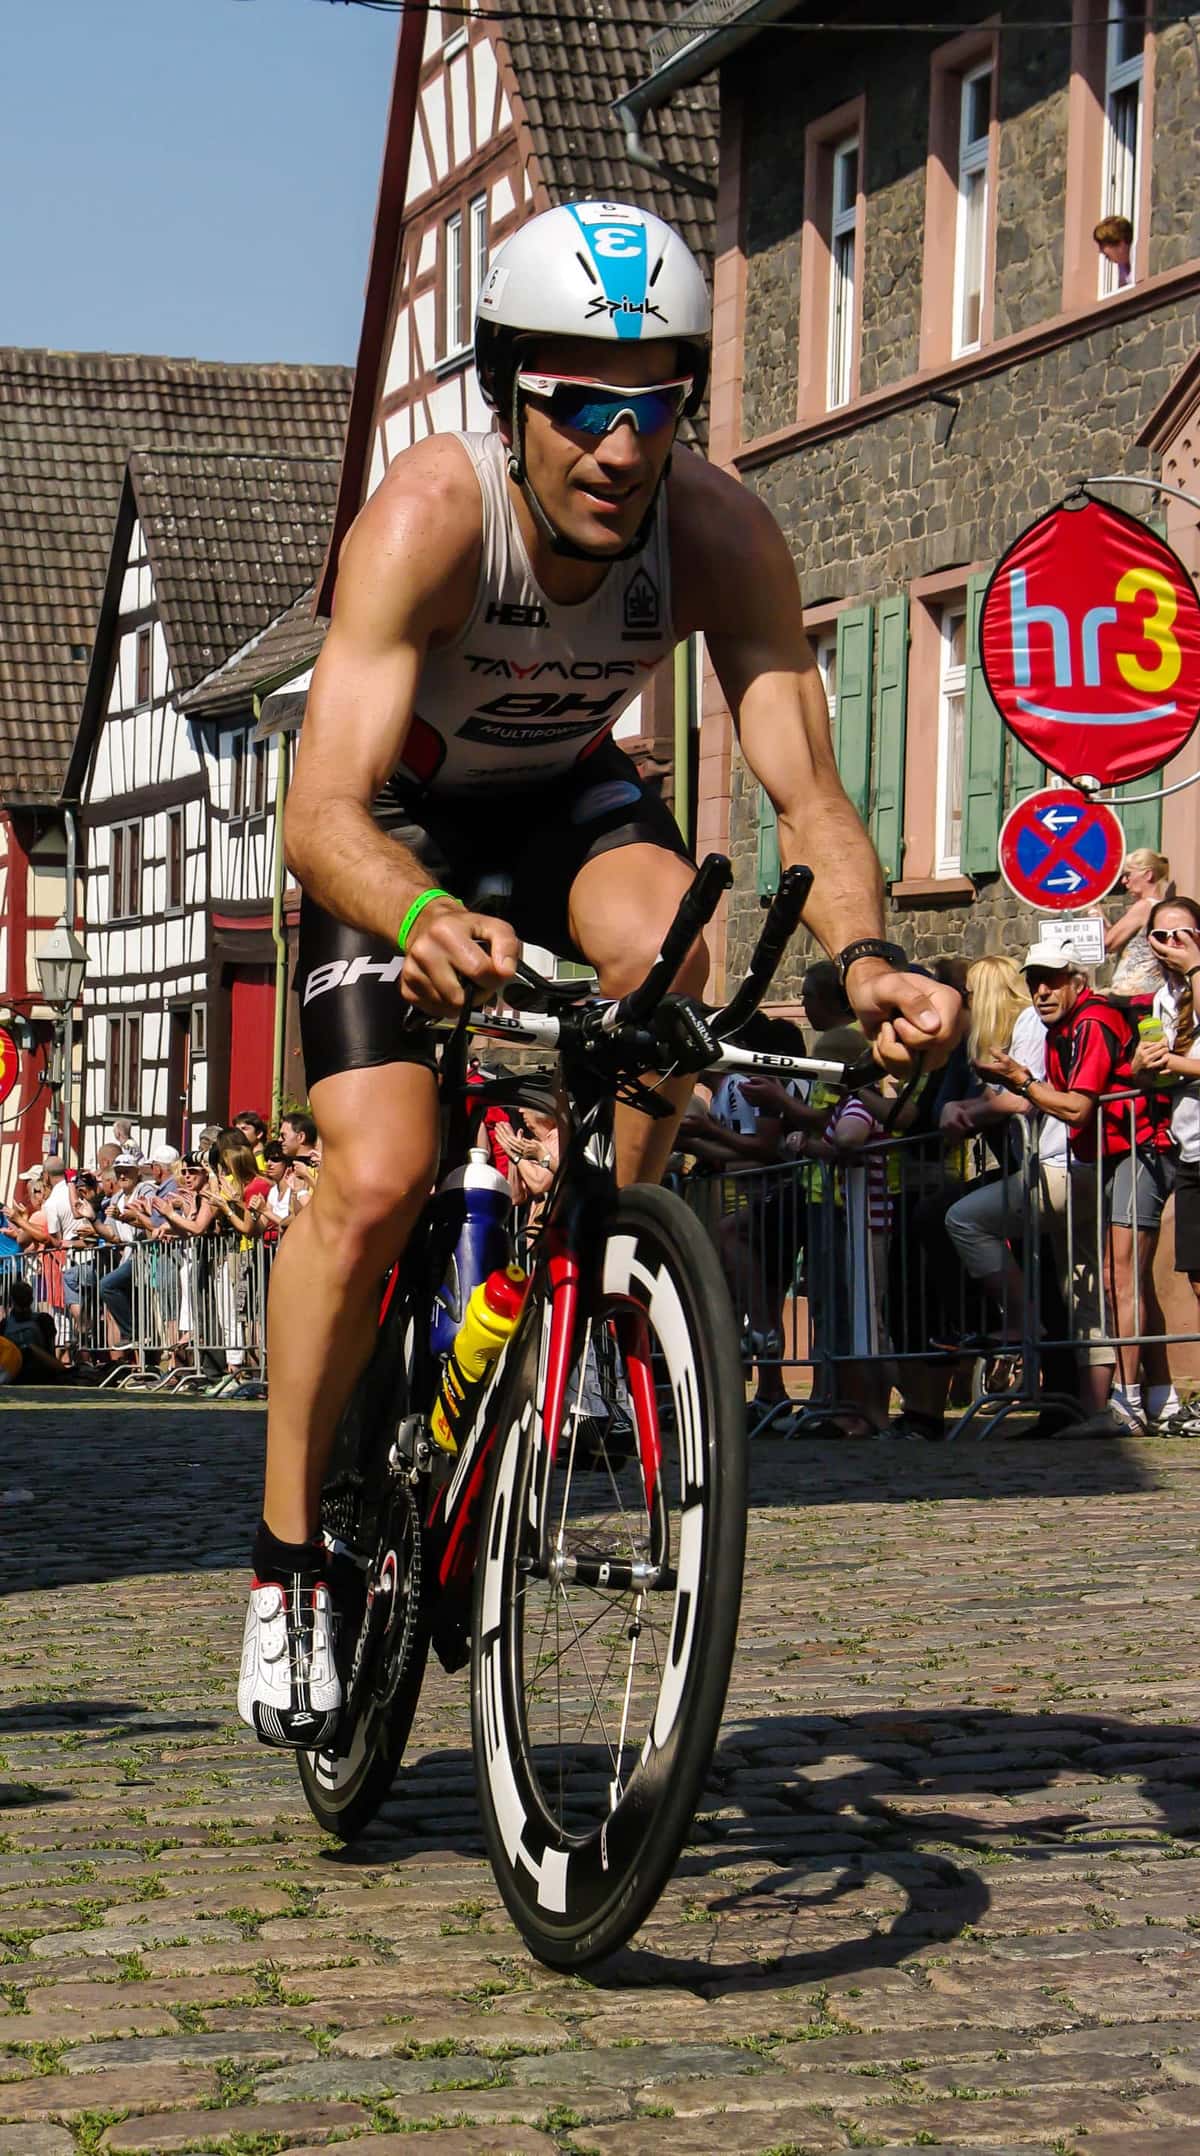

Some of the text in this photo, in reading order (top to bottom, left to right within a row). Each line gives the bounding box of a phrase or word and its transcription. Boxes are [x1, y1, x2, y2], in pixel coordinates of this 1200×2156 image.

[1009, 567, 1182, 692] hr3
[475, 688, 628, 717] BH
[303, 955, 406, 1007] BH
